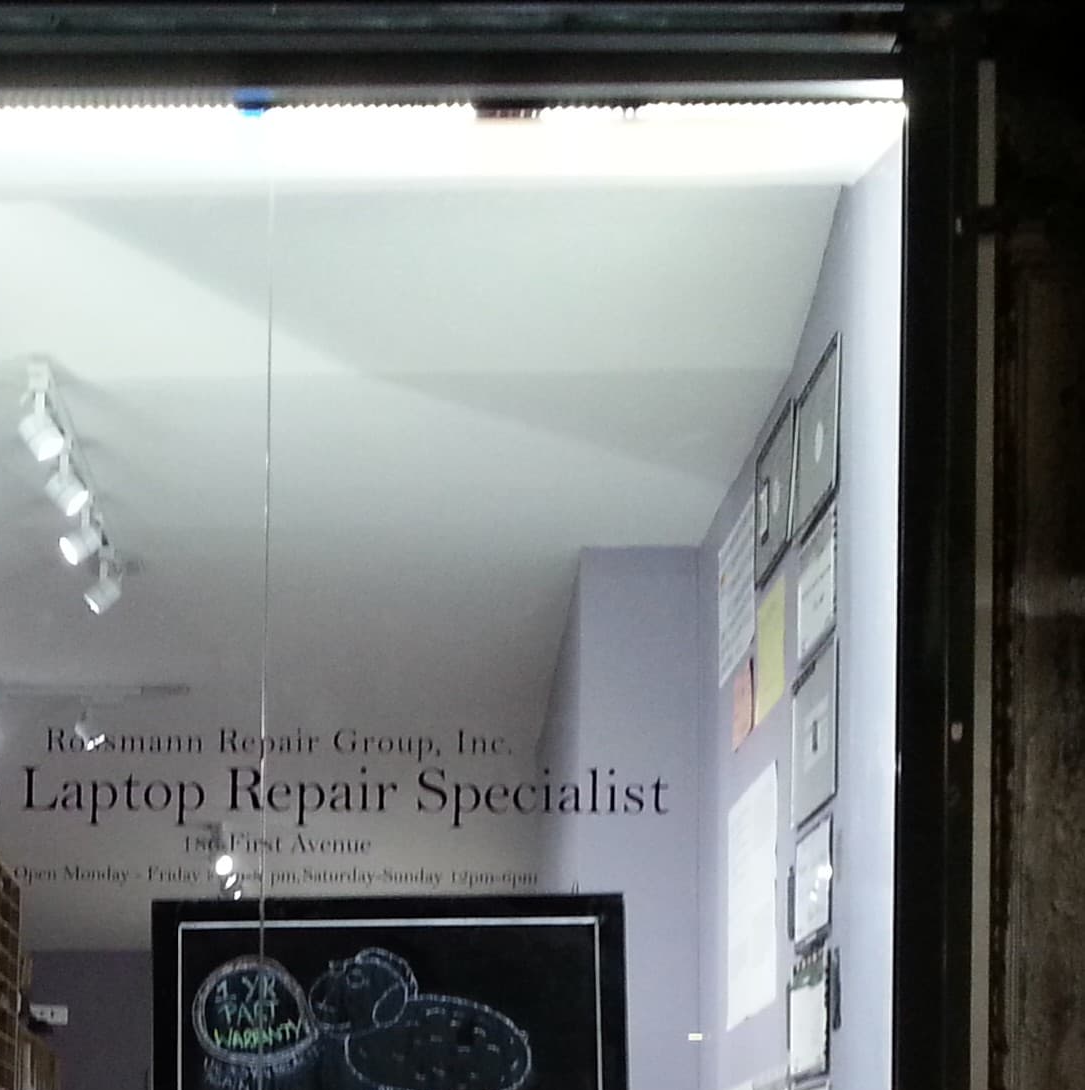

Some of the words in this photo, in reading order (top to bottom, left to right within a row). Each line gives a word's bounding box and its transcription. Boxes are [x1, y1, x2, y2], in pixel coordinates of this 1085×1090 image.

[219, 727, 319, 760] Repair
[333, 727, 441, 762] Group,
[457, 728, 512, 755] Inc.
[23, 765, 205, 826] Laptop
[228, 765, 398, 827] Repair
[416, 766, 669, 828] Specialist
[230, 833, 280, 852] First
[291, 834, 371, 853] Avenue
[13, 864, 57, 885] Open
[64, 864, 129, 885] Monday
[147, 865, 199, 885] Friday
